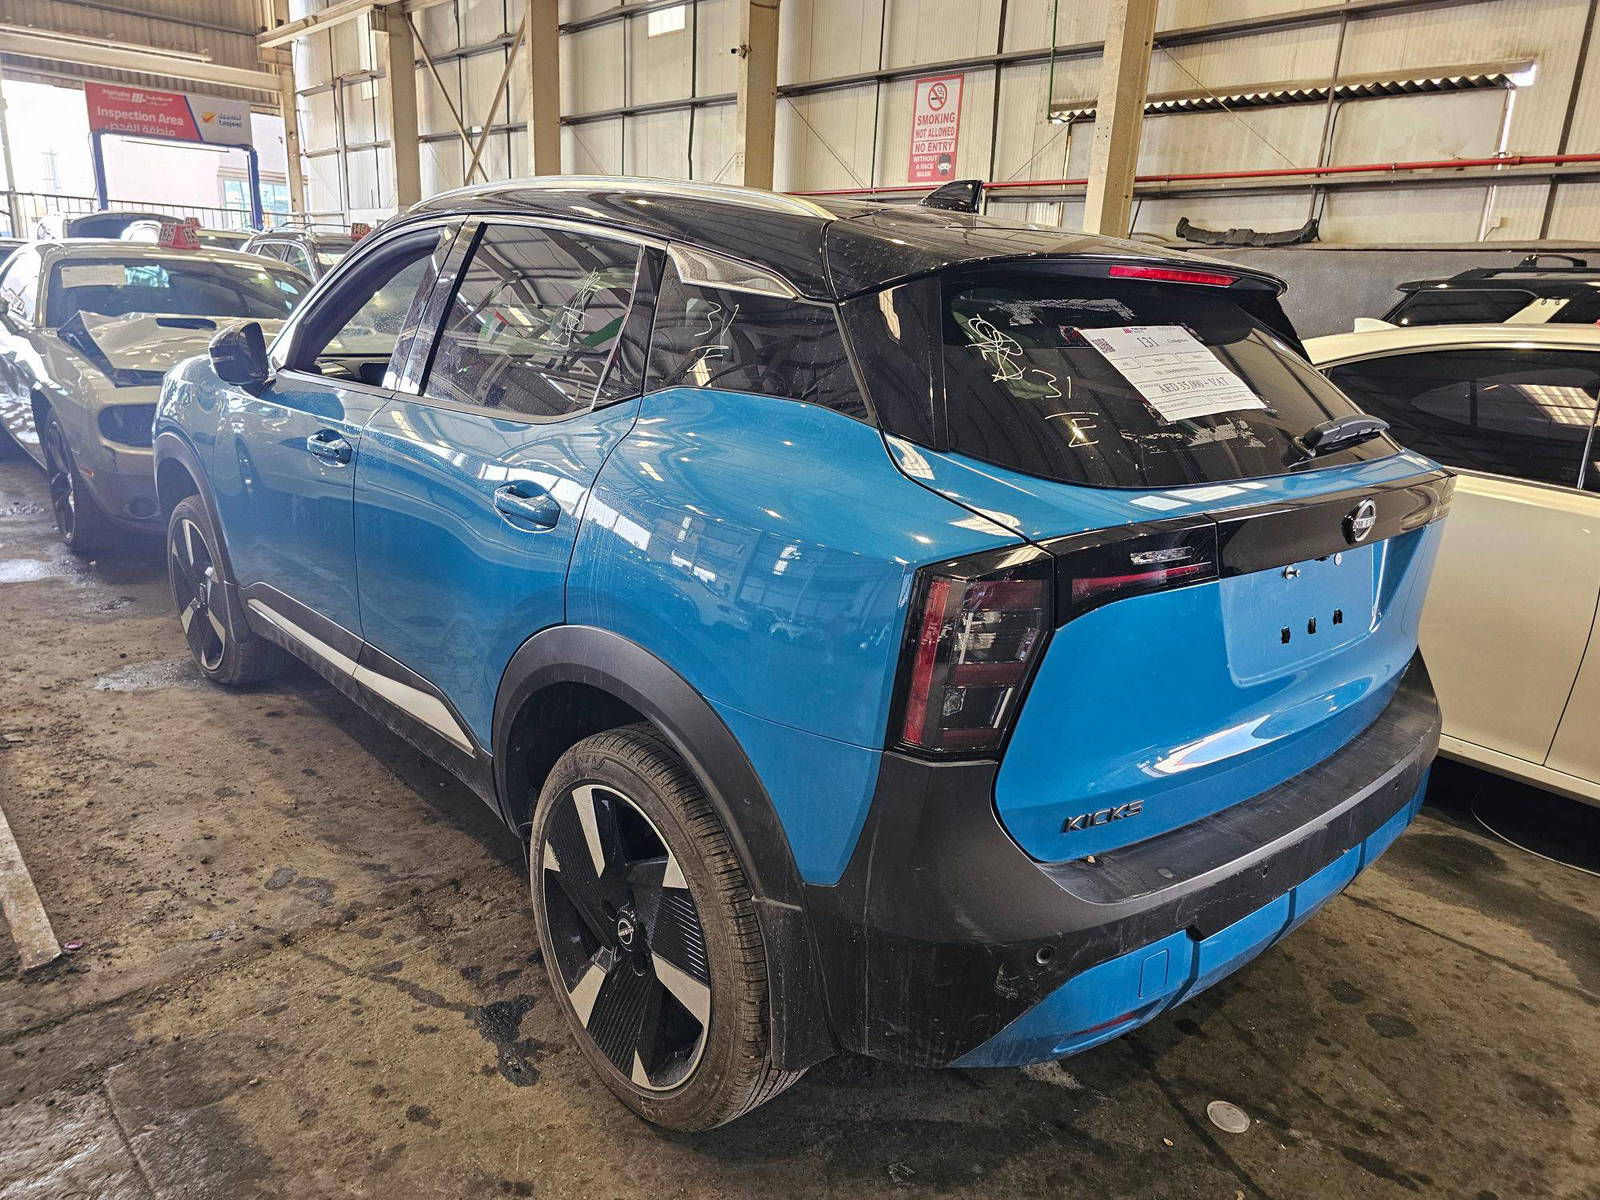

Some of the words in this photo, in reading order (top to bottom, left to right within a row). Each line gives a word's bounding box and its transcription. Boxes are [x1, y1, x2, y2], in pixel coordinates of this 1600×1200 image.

[97, 105, 156, 122] Inspection
[158, 113, 184, 126] Area
[917, 112, 956, 126] SMOKING
[915, 128, 927, 139] NOT
[927, 126, 955, 138] ALLOWED
[915, 142, 926, 153] NO
[928, 141, 953, 152] ENTRY
[1137, 336, 1160, 349] 131
[1032, 369, 1072, 399] 31
[1159, 382, 1179, 394] AED
[1208, 376, 1229, 387] VAT
[1061, 799, 1144, 832] KICKS
